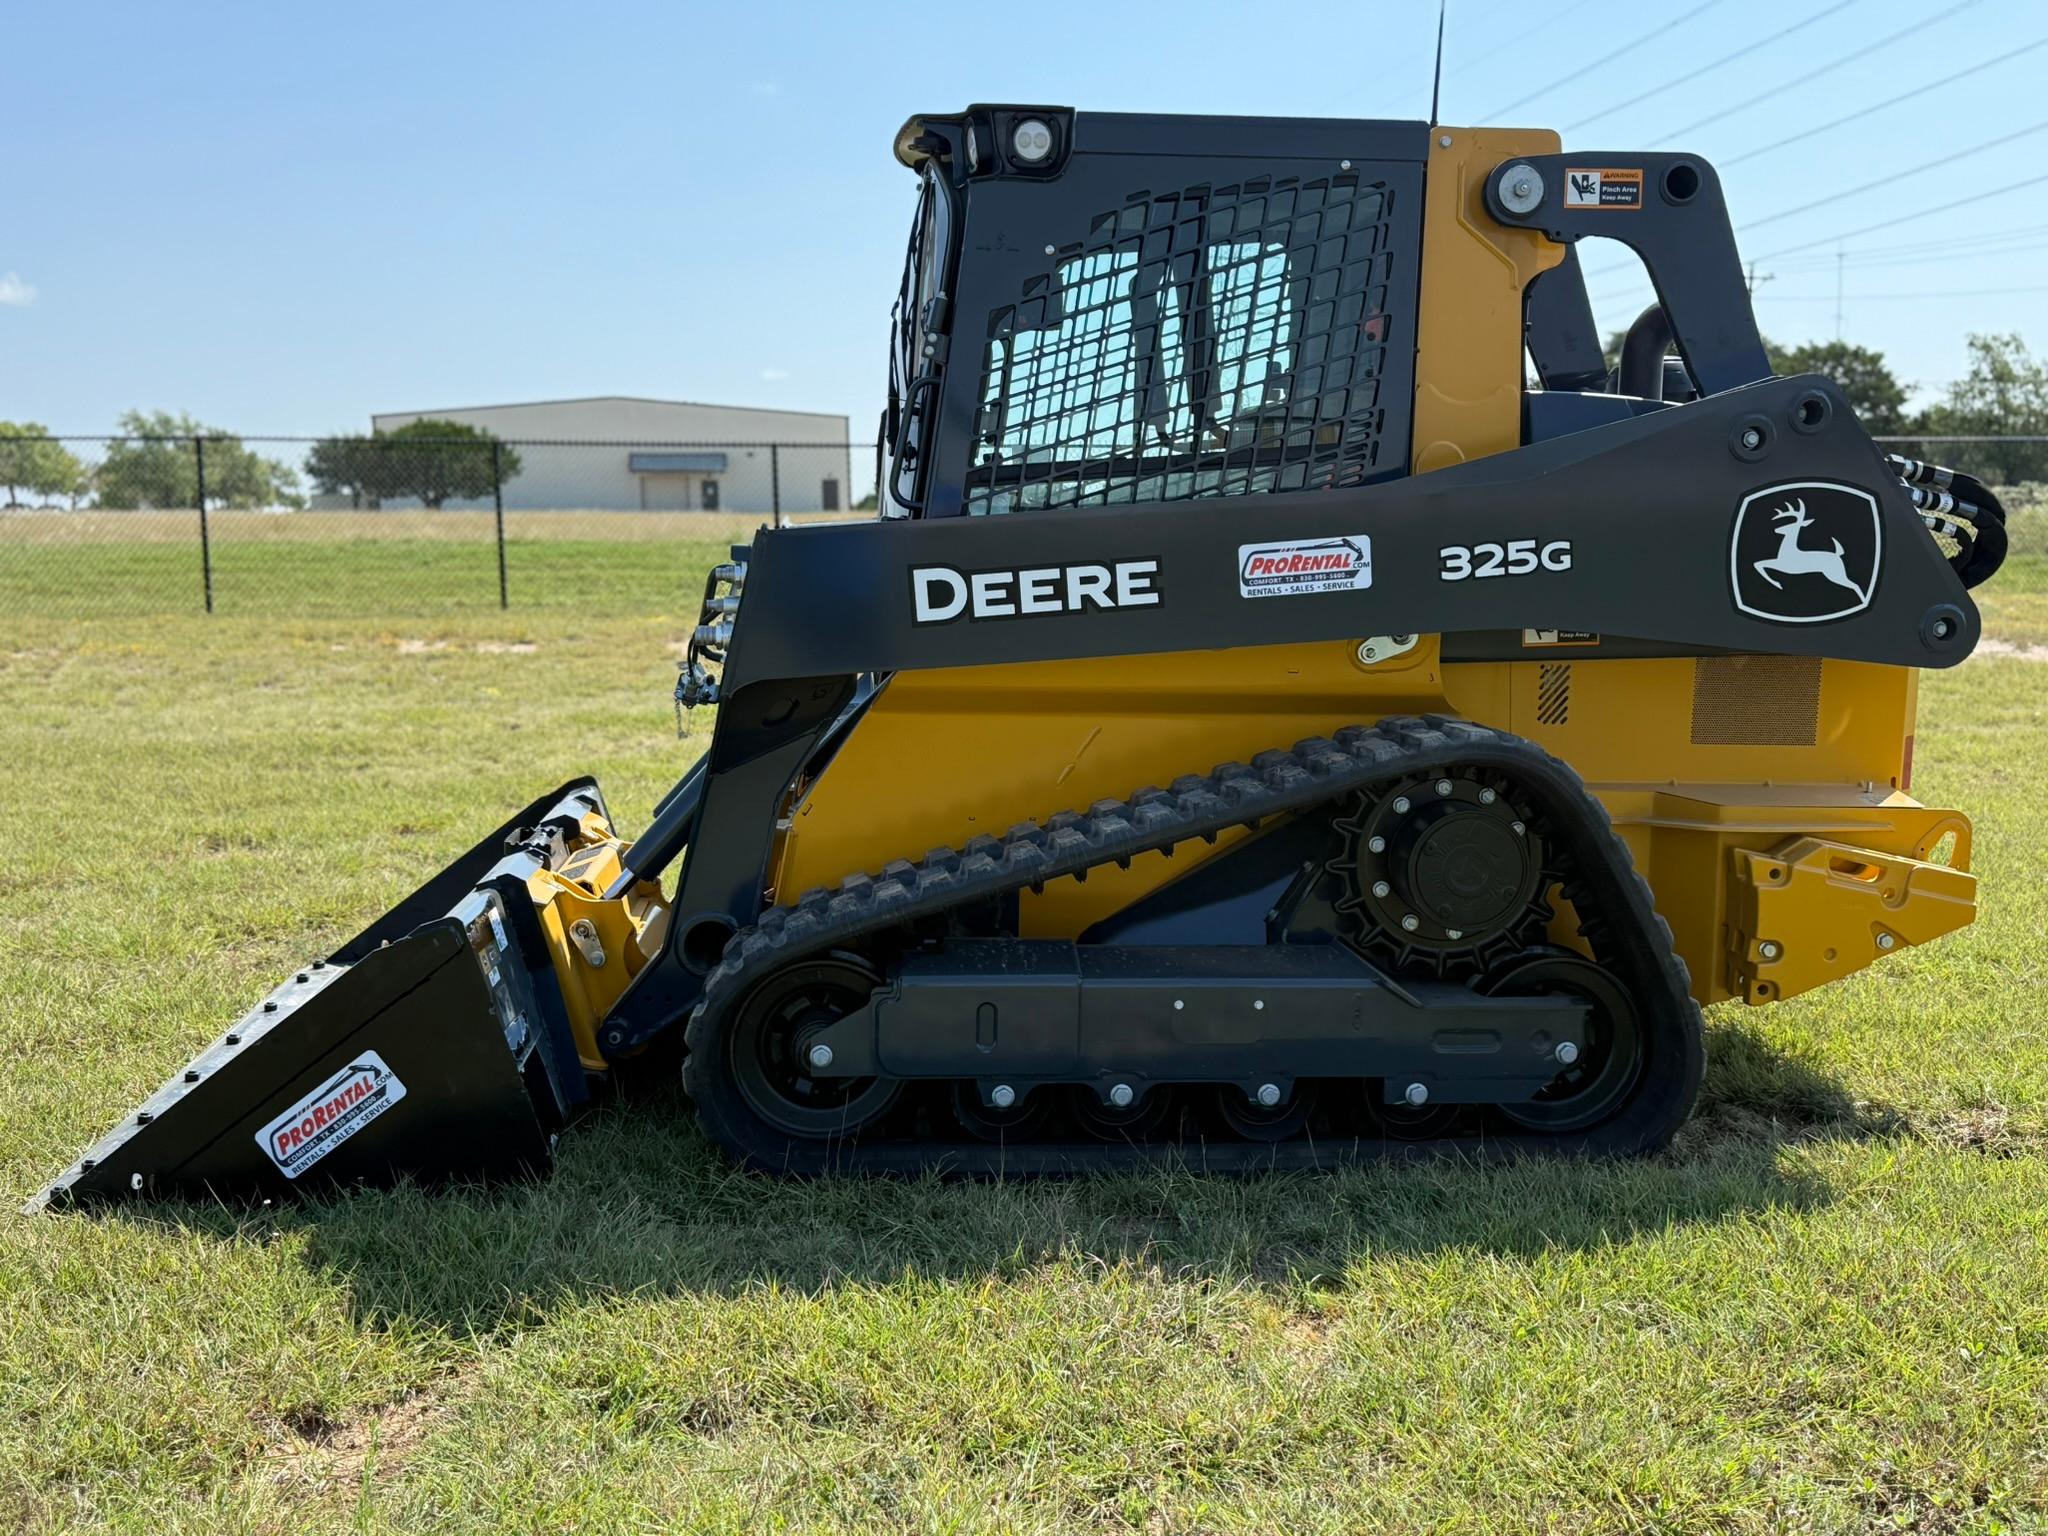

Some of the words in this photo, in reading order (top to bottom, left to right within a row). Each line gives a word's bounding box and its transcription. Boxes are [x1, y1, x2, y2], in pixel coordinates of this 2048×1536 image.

[1609, 171, 1639, 179] WARNING
[1440, 540, 1571, 580] 325G
[913, 561, 1159, 622] DEERE
[1247, 587, 1282, 596] RENTALS
[1290, 584, 1315, 593] SALES
[1323, 580, 1355, 590] SERVICE
[291, 1147, 326, 1175] RENTALS
[331, 1125, 356, 1146] SALES
[360, 1098, 393, 1123] SERVICE
[320, 1130, 331, 1140] TX
